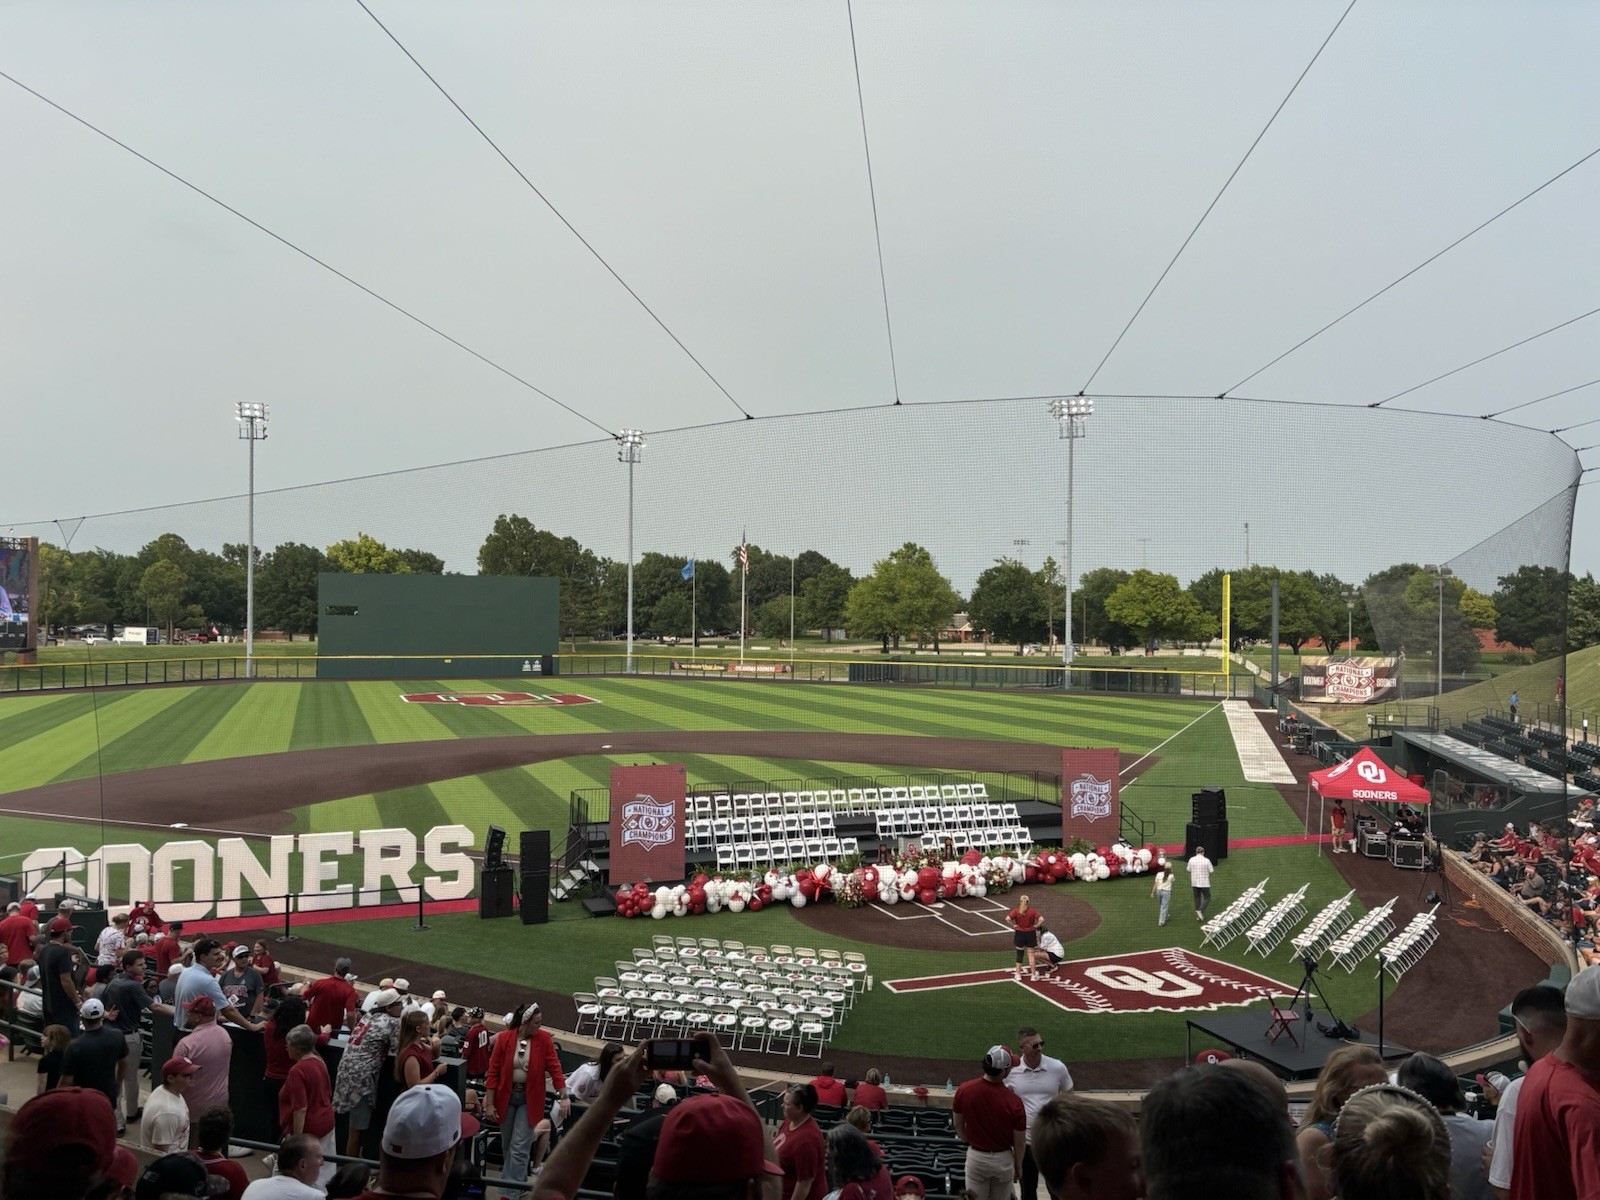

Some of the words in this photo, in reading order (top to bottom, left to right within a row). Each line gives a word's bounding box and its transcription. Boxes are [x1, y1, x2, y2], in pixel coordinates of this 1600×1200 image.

[1335, 665, 1364, 676] NATIONAL
[1303, 676, 1324, 686] BOOMER
[1376, 678, 1397, 687] SOONER
[1332, 686, 1368, 696] CHAMPIONS
[1357, 760, 1387, 784] OU
[1079, 783, 1103, 792] NATIONAL
[1352, 789, 1398, 800] SOONERS
[633, 806, 665, 815] NATIONAL
[1077, 805, 1106, 813] CHAMPIONS
[629, 830, 669, 840] CHAMPIONS
[22, 824, 475, 922] SOONERS
[1084, 964, 1204, 999] OU
[478, 1030, 488, 1048] 10
